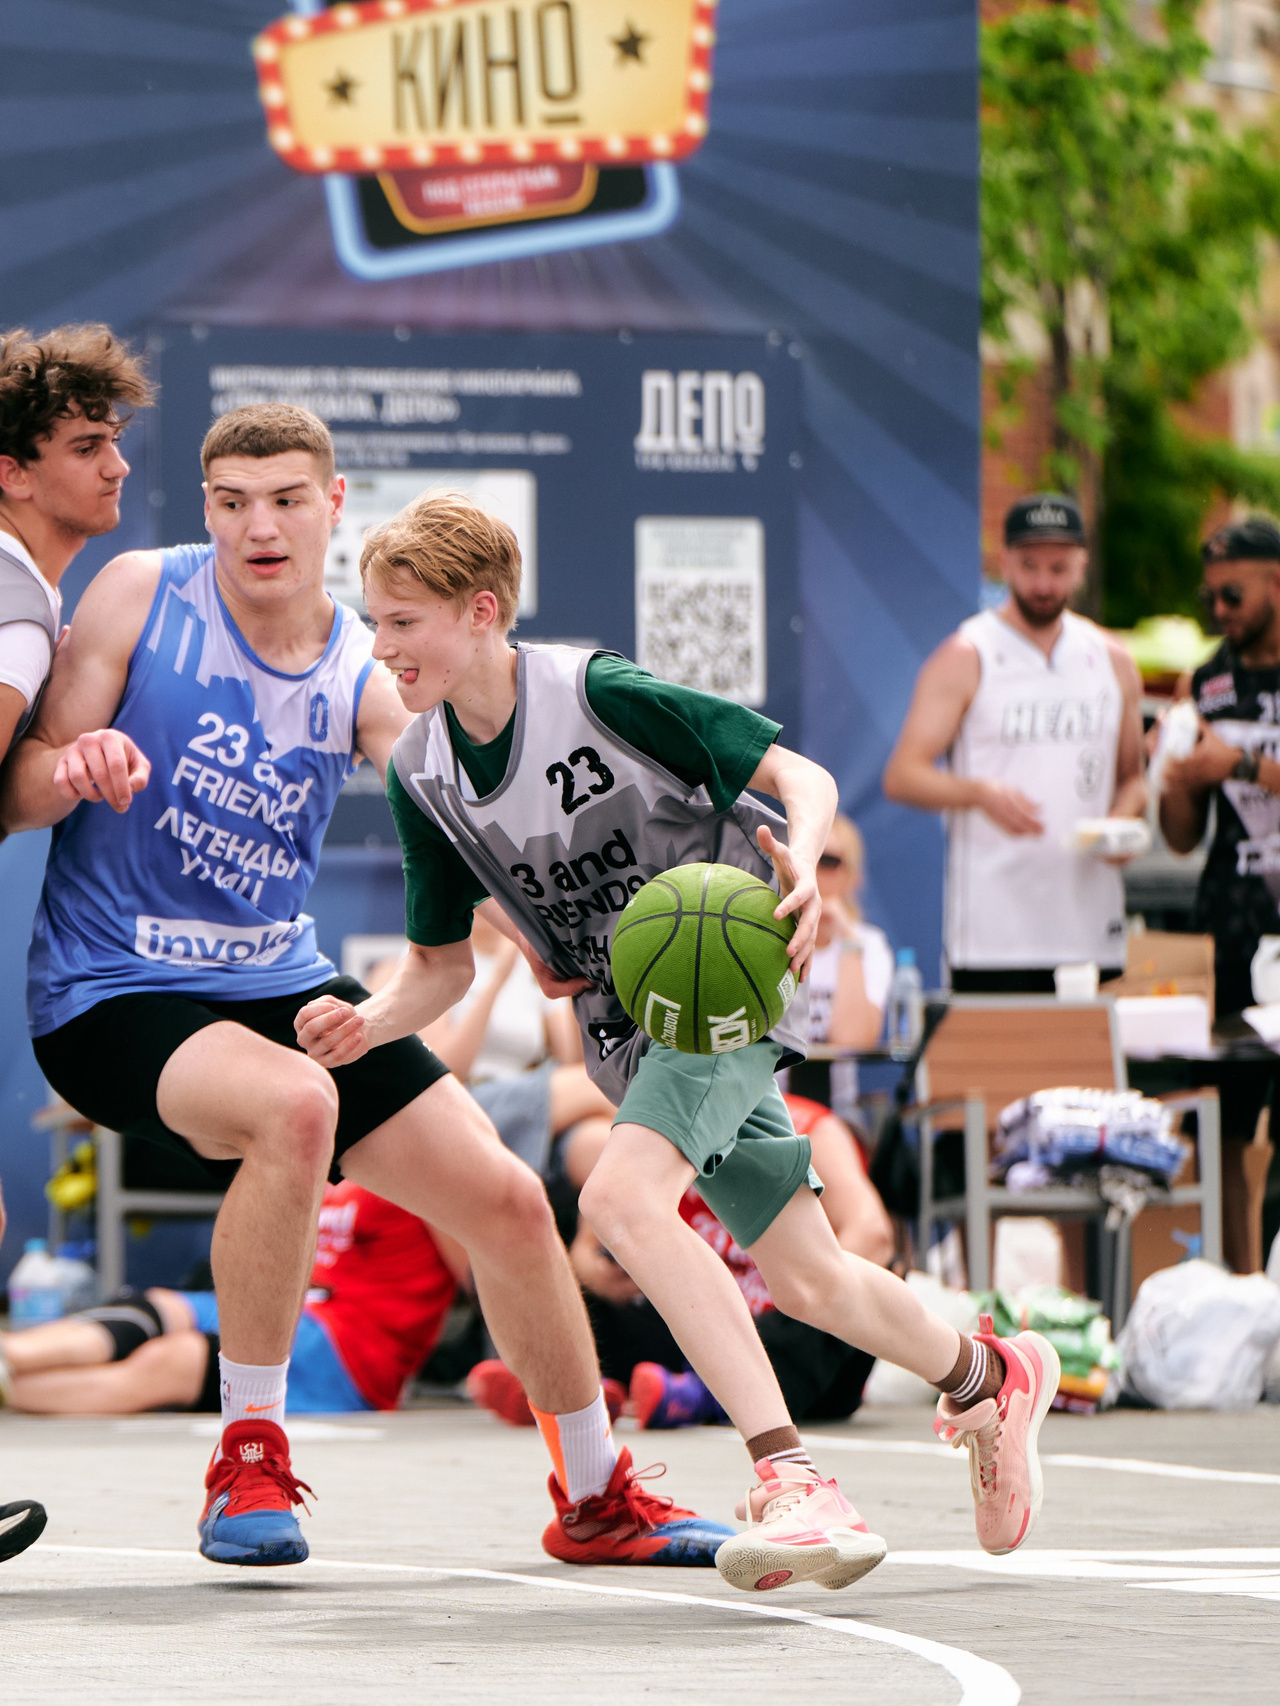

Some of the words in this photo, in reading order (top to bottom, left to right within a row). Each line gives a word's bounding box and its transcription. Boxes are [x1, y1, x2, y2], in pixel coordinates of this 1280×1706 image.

[391, 0, 582, 133] КИНО
[634, 369, 765, 456] ДЕПО
[187, 711, 250, 768] 23
[253, 748, 314, 814] and
[546, 746, 615, 816] 23
[153, 806, 300, 880] ЛЕГЕНДЫ
[509, 862, 546, 899] 3
[548, 828, 638, 893] and
[147, 922, 300, 962] invoke
